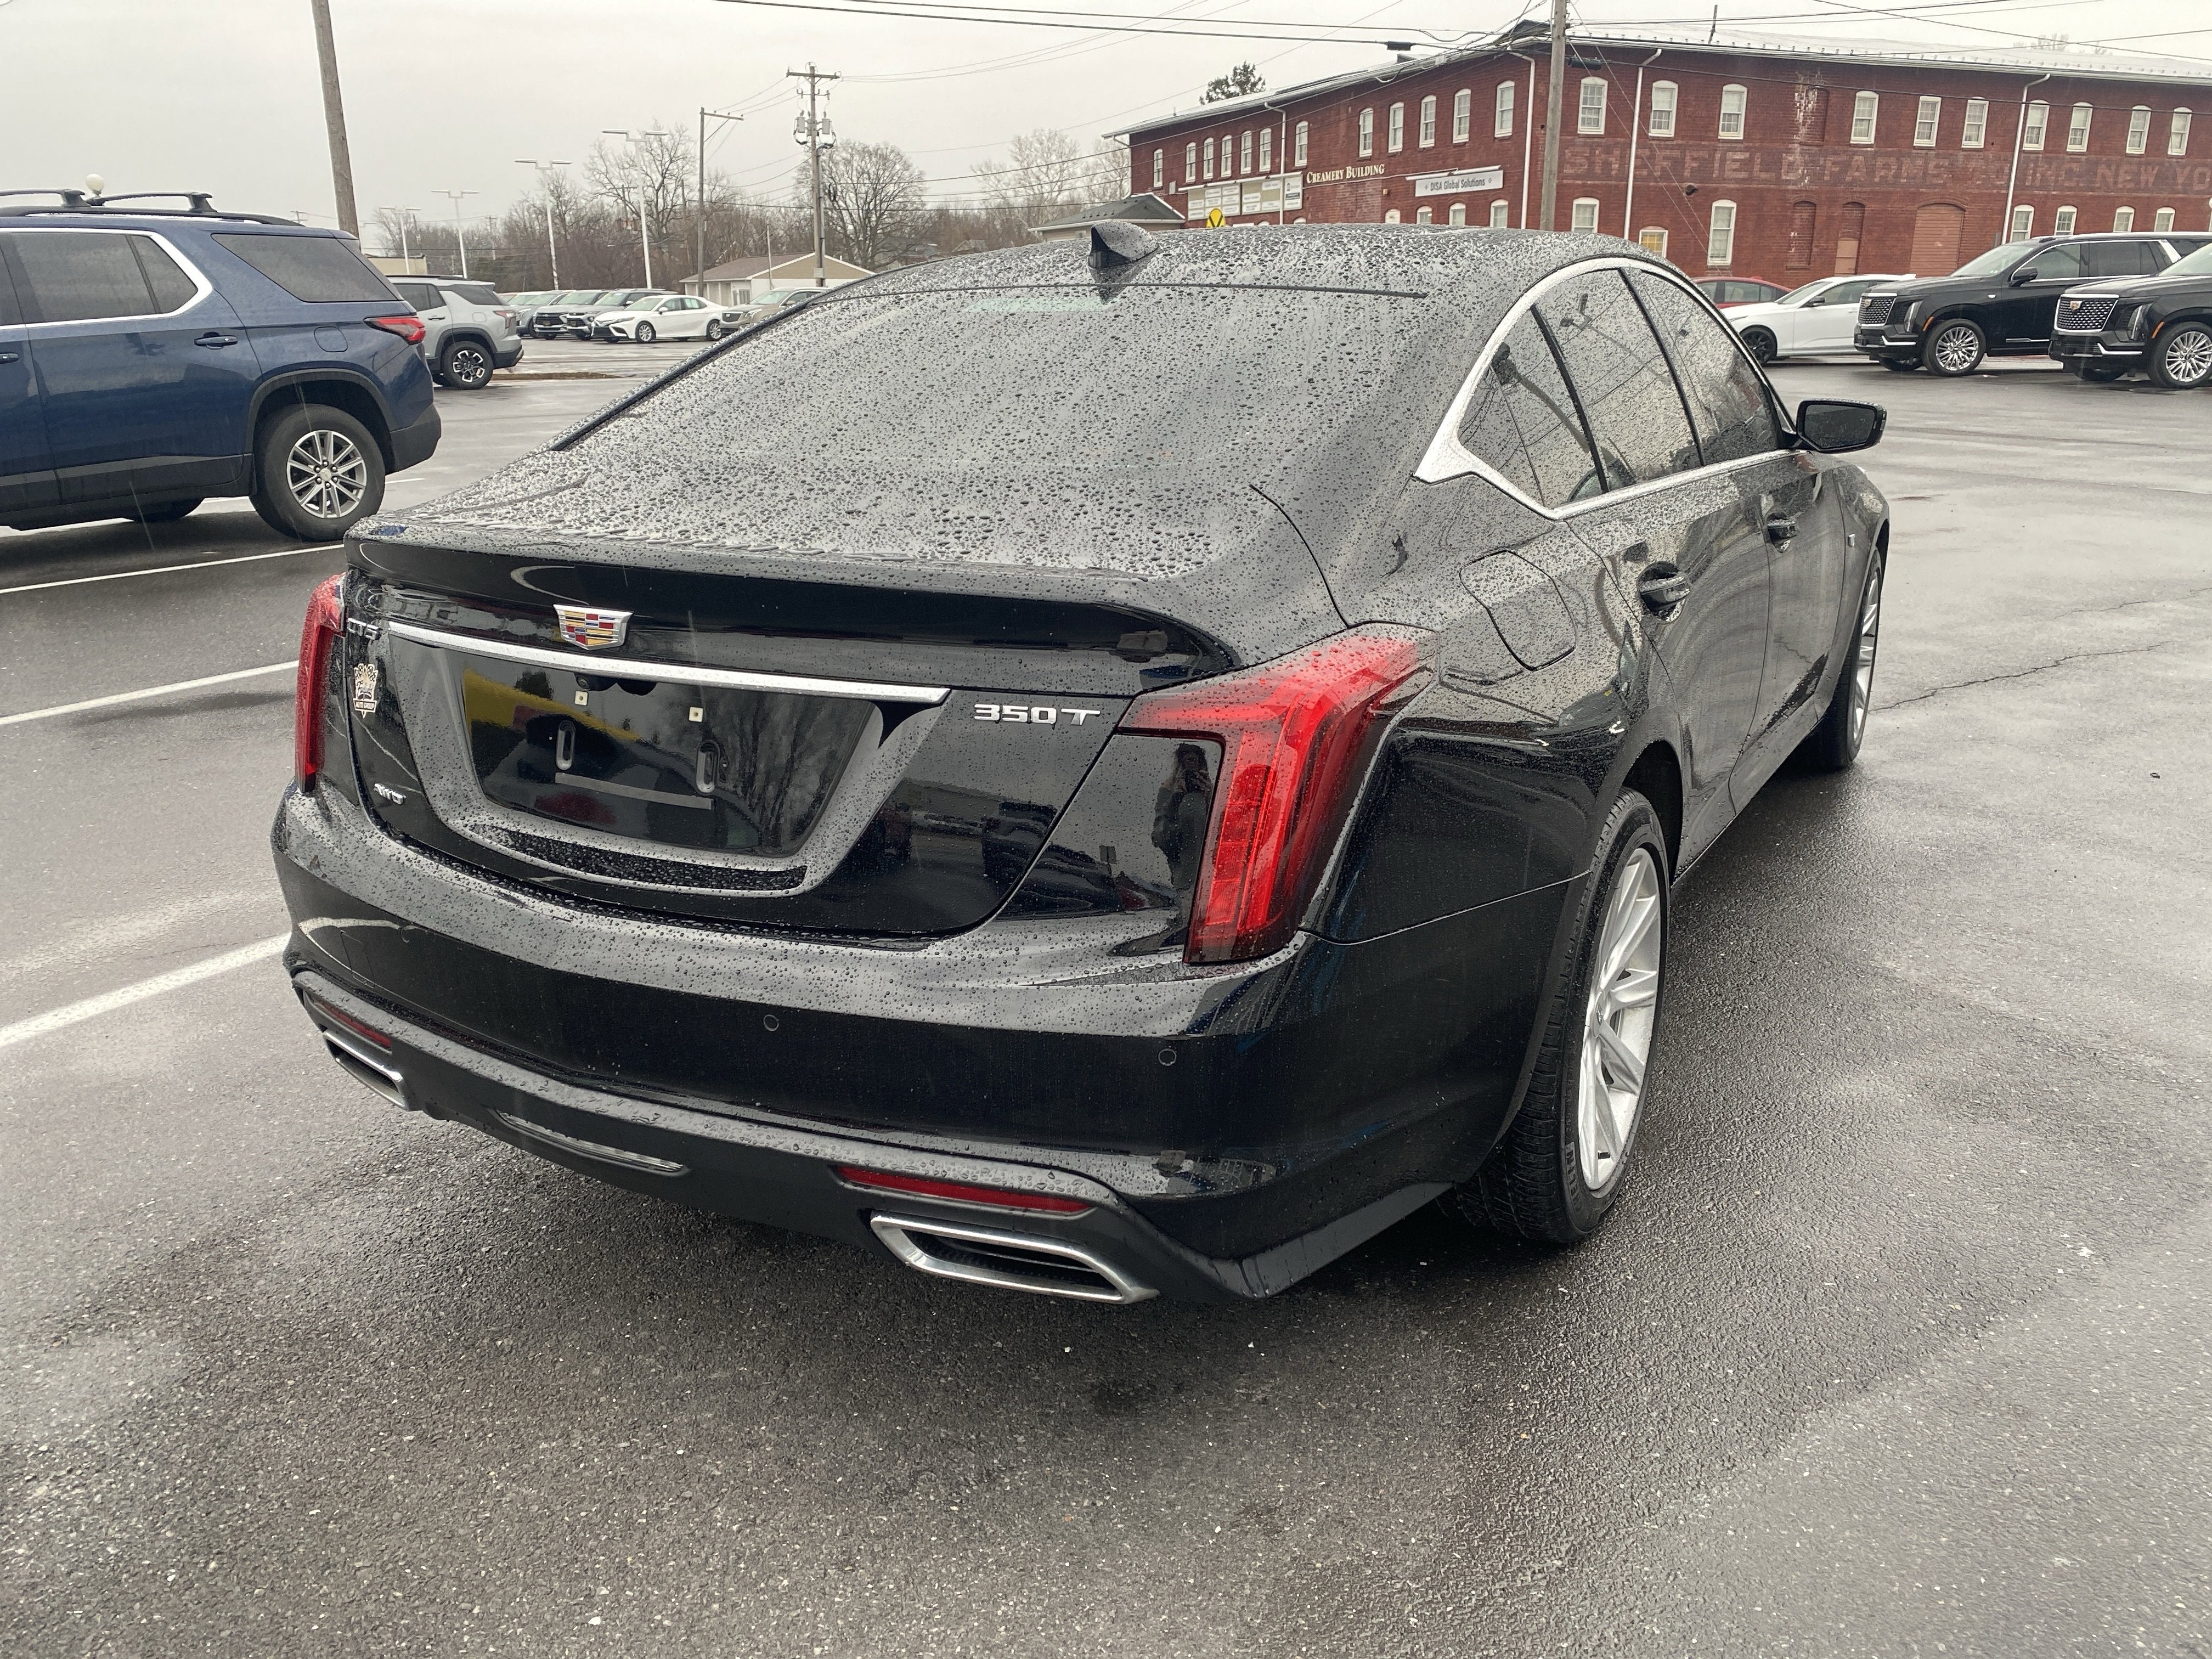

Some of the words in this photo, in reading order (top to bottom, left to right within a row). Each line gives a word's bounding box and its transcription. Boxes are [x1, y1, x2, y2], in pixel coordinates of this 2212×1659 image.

[1306, 169, 1344, 184] CREAMERY
[1346, 163, 1385, 179] BUILDING
[1563, 146, 1805, 180] SHEFFIELD
[2095, 163, 2159, 189] NEW
[1430, 182, 1442, 191] DISA
[1443, 179, 1459, 190] Global
[1461, 178, 1485, 188] Solutions
